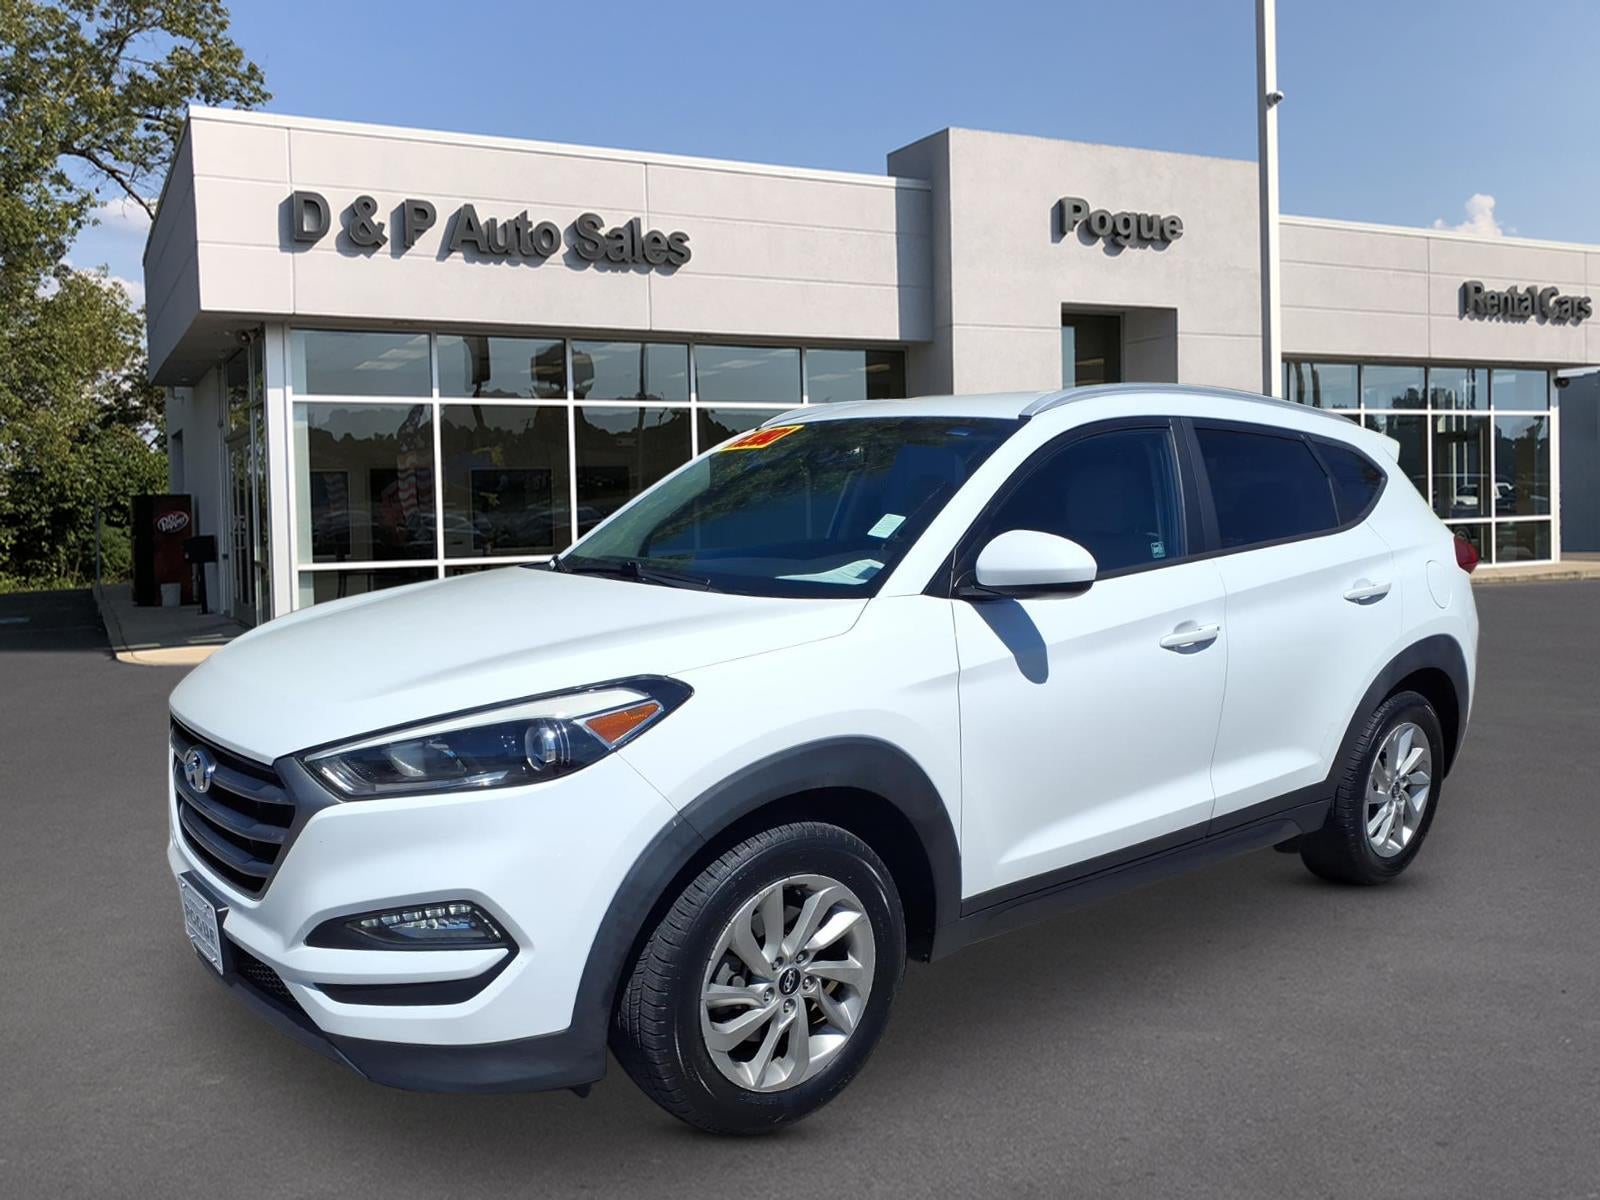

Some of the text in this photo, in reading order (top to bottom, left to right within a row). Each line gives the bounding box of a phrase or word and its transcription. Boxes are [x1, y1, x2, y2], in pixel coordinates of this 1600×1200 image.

[292, 190, 692, 266] D & P Auto Sales
[1060, 196, 1184, 247] Pogue
[1461, 281, 1593, 323] Rental Cars
